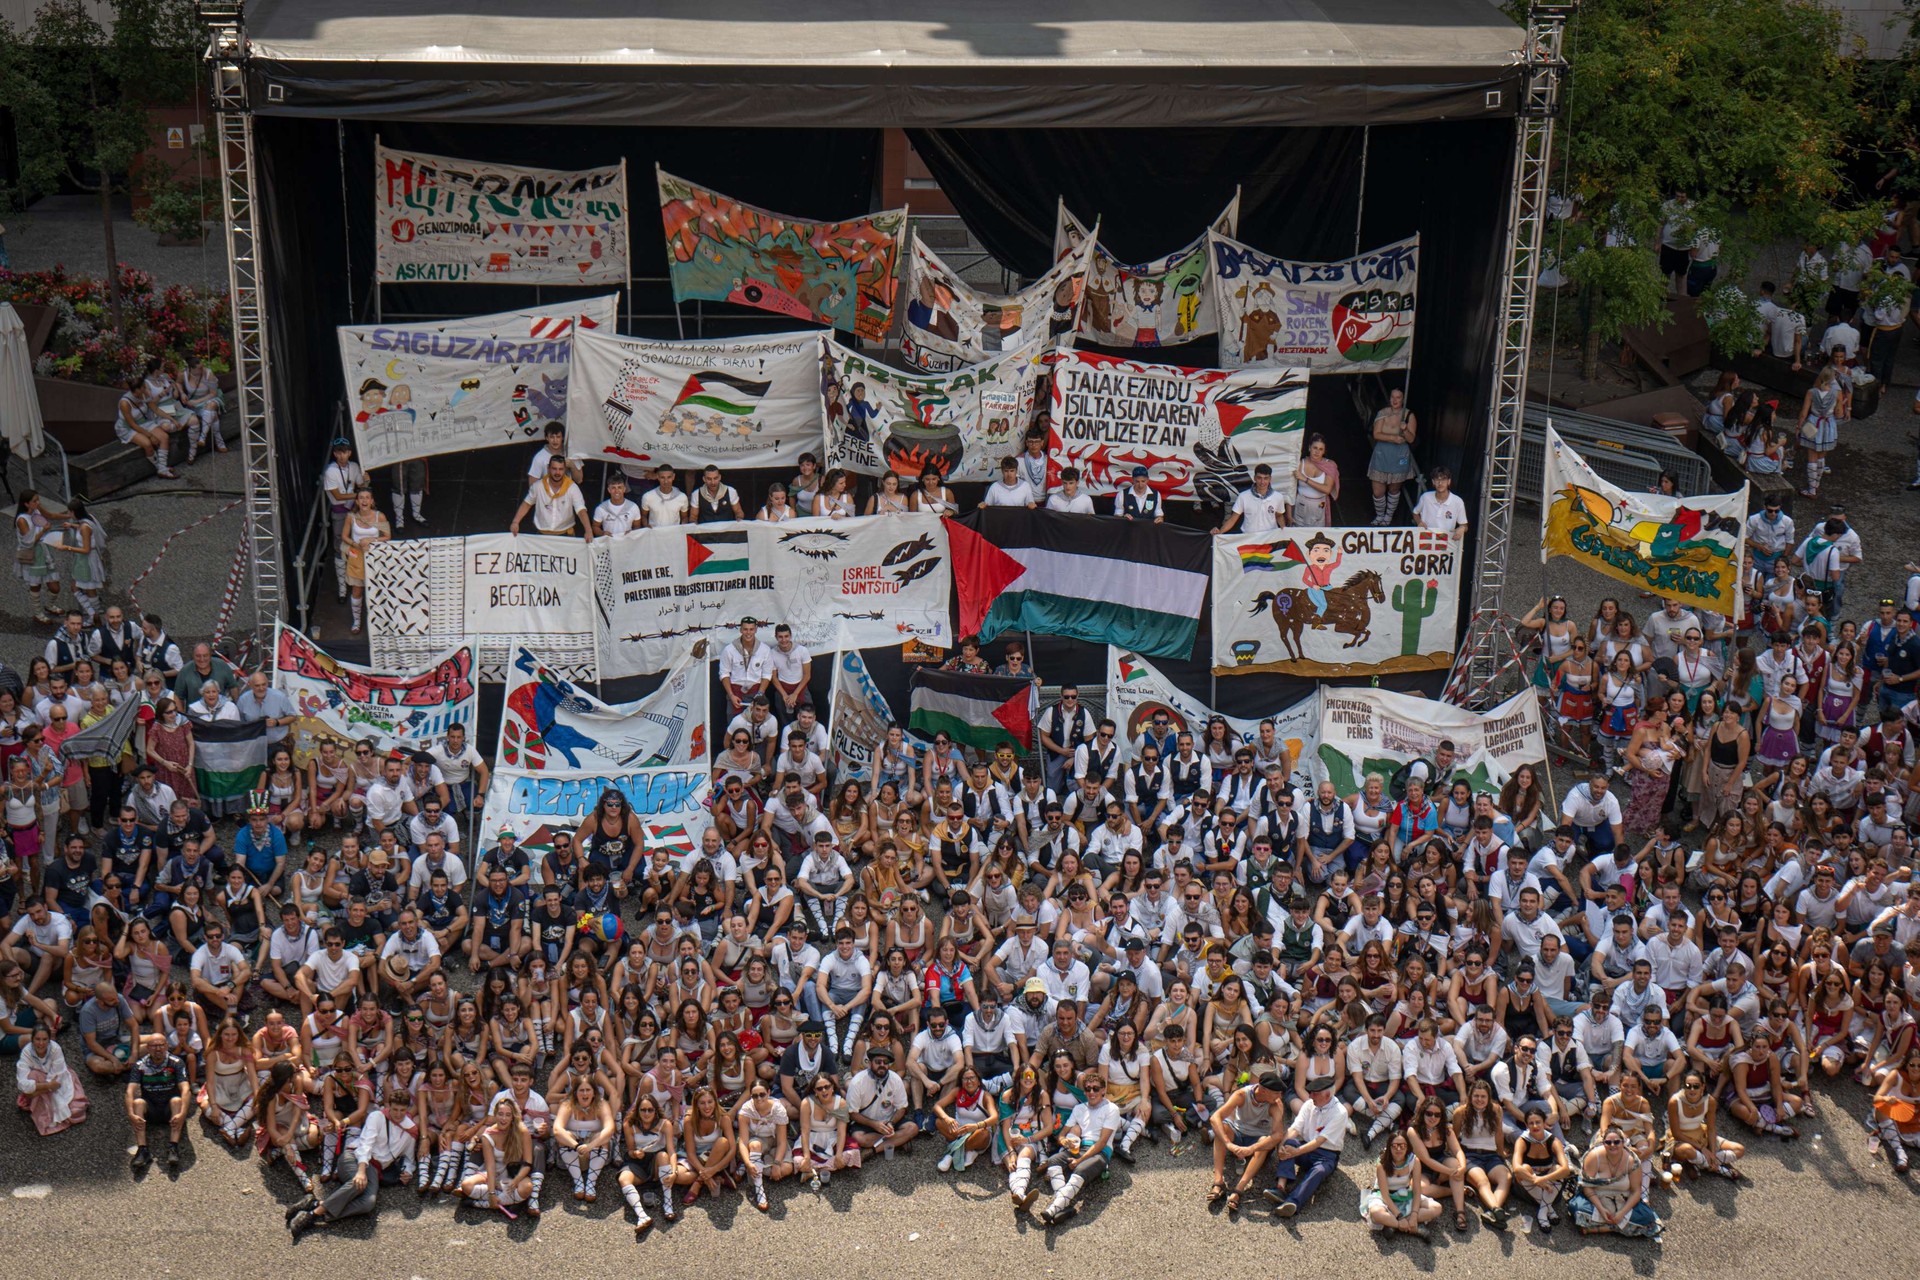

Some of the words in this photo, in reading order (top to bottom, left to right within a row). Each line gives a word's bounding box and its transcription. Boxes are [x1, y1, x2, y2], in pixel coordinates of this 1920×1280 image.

[416, 221, 481, 236] GENOZIDIOA!
[396, 263, 468, 280] ASKATU!
[1352, 296, 1412, 310] ASKE
[1284, 330, 1330, 346] 2025
[1063, 370, 1125, 395] JAIAK
[1127, 376, 1166, 400] EZIN
[1167, 380, 1192, 403] DU
[1064, 393, 1200, 427] ISILTASUNAREN
[1062, 416, 1139, 444] KONPLIZE
[1142, 424, 1187, 447] IZAN
[843, 435, 874, 453] FREE
[1341, 531, 1414, 554] GALTZA
[474, 552, 501, 575] EZ
[506, 551, 577, 575] BAZTERTU
[622, 568, 653, 584] JAIETAN
[655, 565, 674, 579] ERE,
[843, 566, 886, 581] ISRAEL
[490, 584, 561, 608] BEGIRADA
[624, 586, 671, 603] PALESTINAR
[673, 578, 747, 597] ERRESISTENTZIAREN
[749, 575, 775, 591] ALDE
[841, 581, 900, 595] SUNTSITU
[1326, 698, 1372, 714] ENCUENTRO
[1331, 710, 1372, 725] ANTIGUAS
[1483, 711, 1526, 734] ANTZINAKO
[1347, 725, 1373, 740] PEÑAS
[1485, 721, 1538, 748] LAGUNARTEEN
